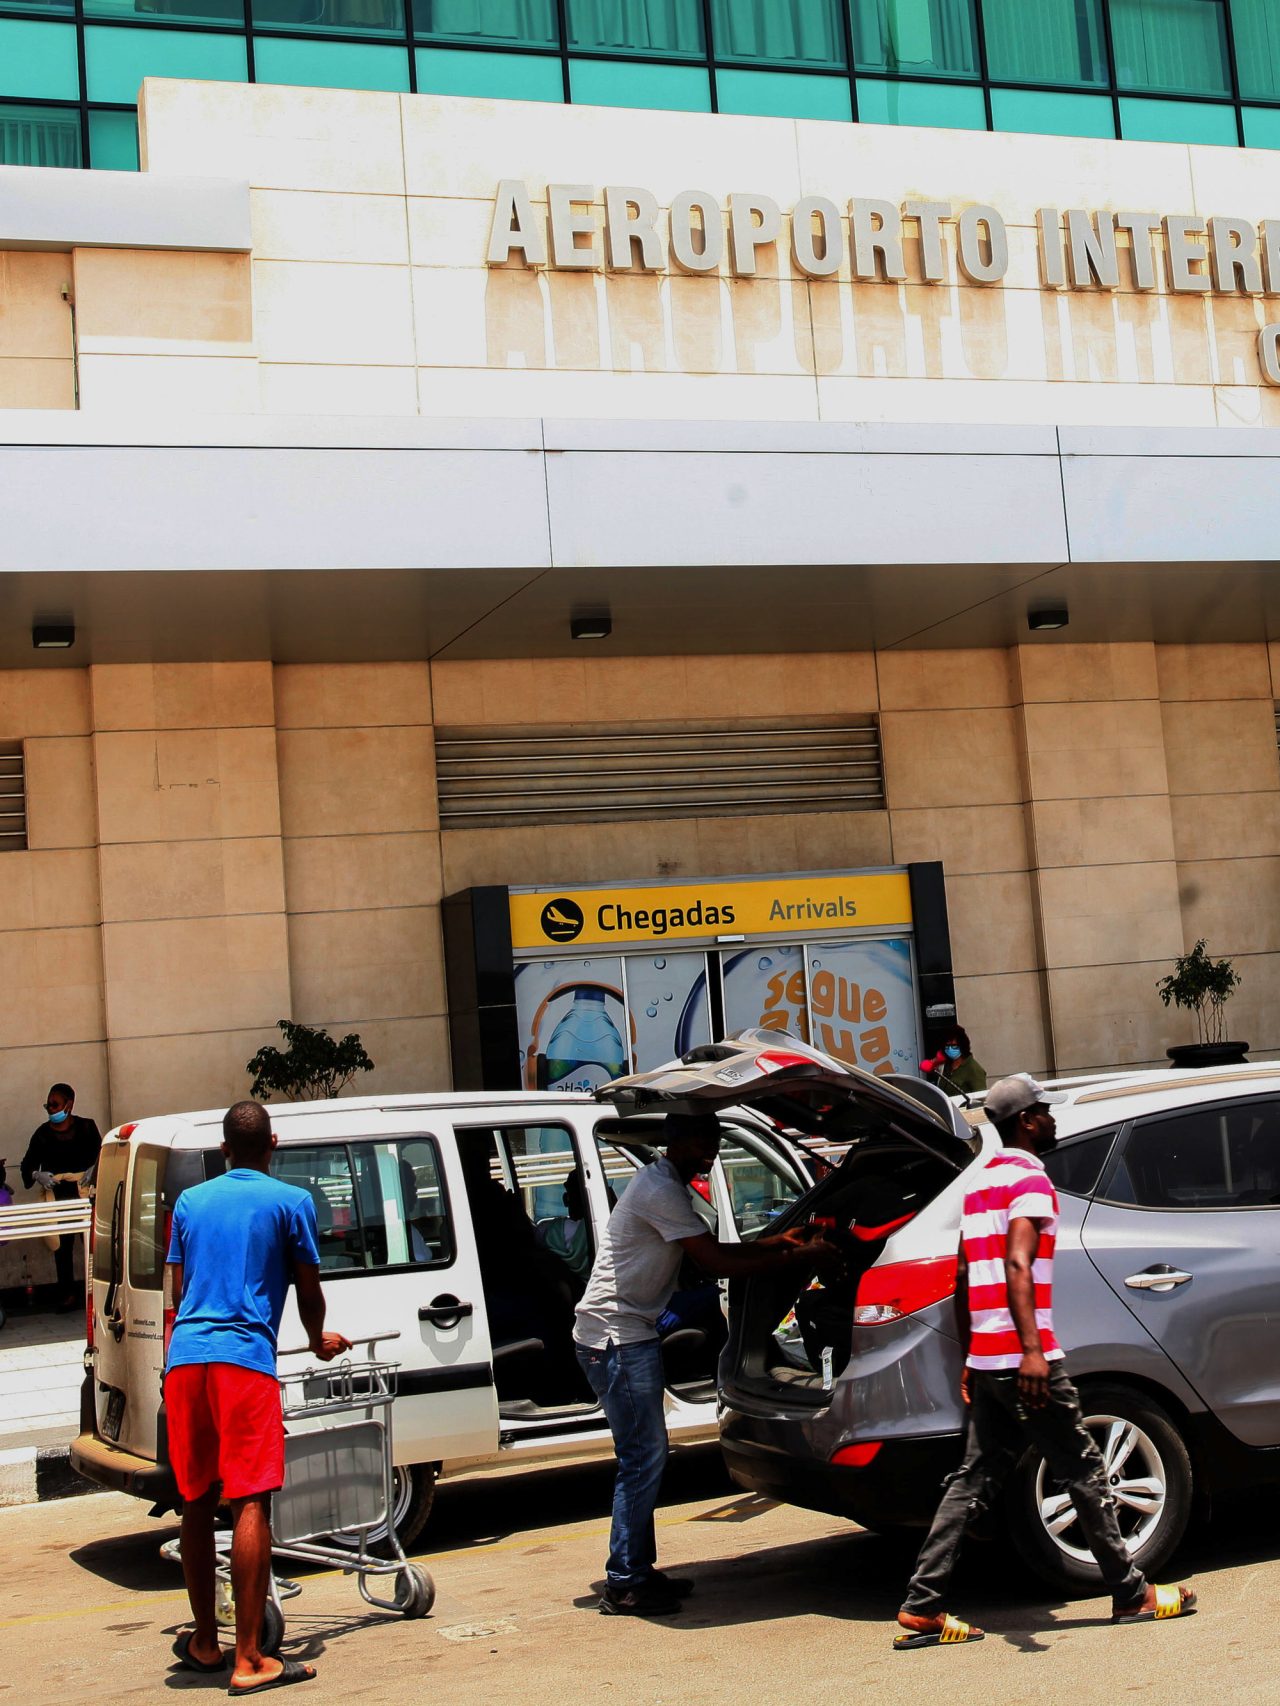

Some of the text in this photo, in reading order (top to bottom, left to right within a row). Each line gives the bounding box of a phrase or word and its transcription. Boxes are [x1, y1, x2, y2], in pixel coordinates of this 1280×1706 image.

[487, 180, 1009, 285] AEROPORTO
[597, 896, 858, 935] Chegadas Arrivals
[763, 970, 888, 1024] segue
